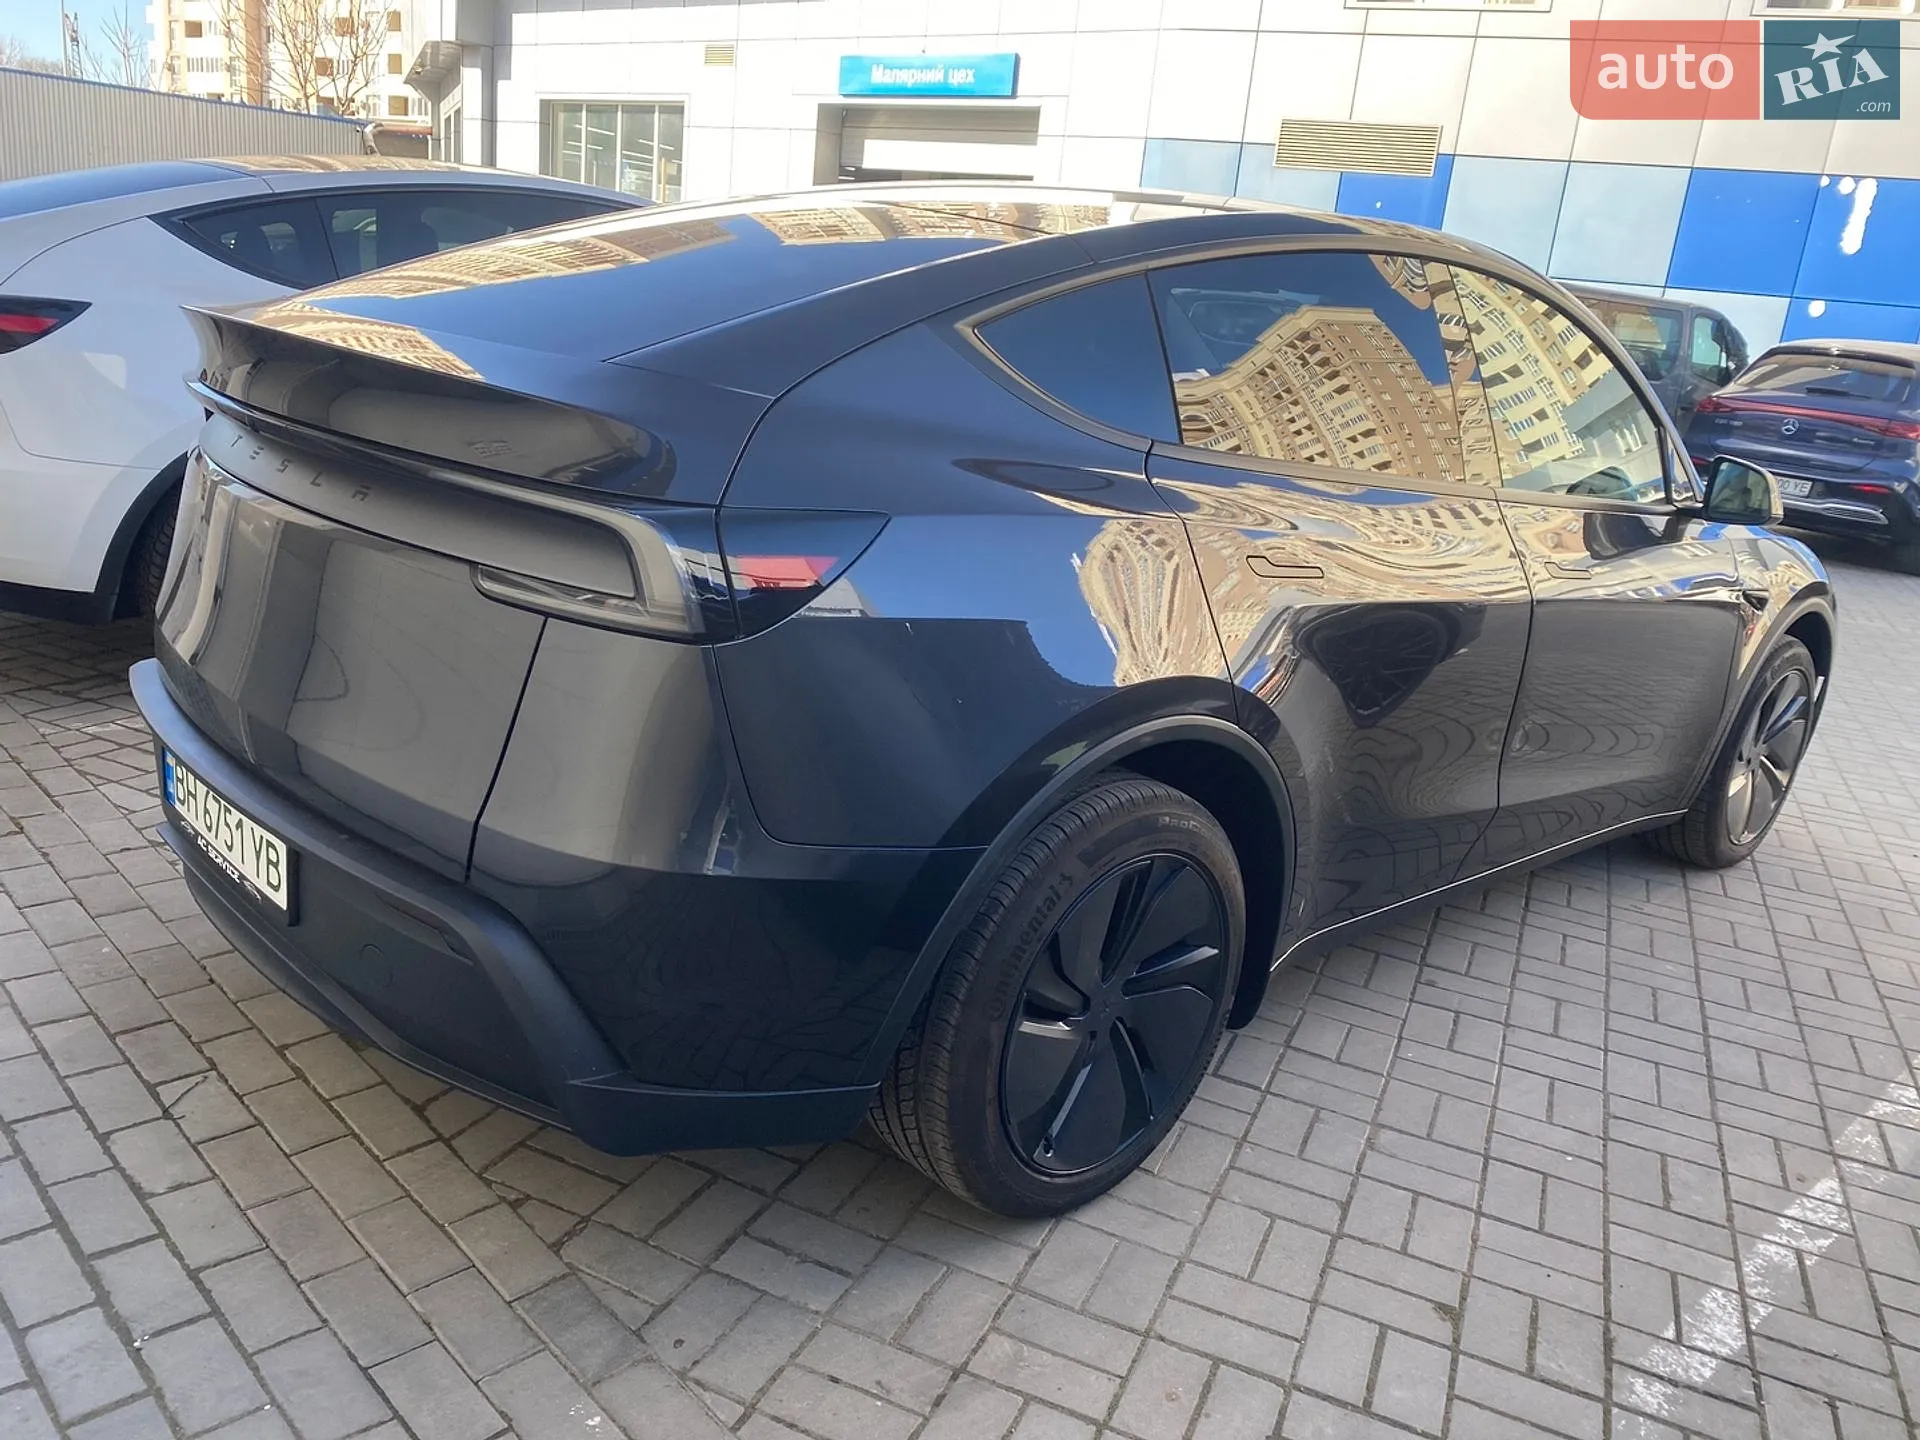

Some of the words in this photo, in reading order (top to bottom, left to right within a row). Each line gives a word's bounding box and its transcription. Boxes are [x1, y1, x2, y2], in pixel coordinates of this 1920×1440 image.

[870, 63, 944, 87] Малярний
[948, 68, 976, 87] цех
[230, 434, 372, 502] TESLA
[175, 764, 199, 821] BH
[203, 789, 245, 865] 6751
[251, 826, 282, 893] YB
